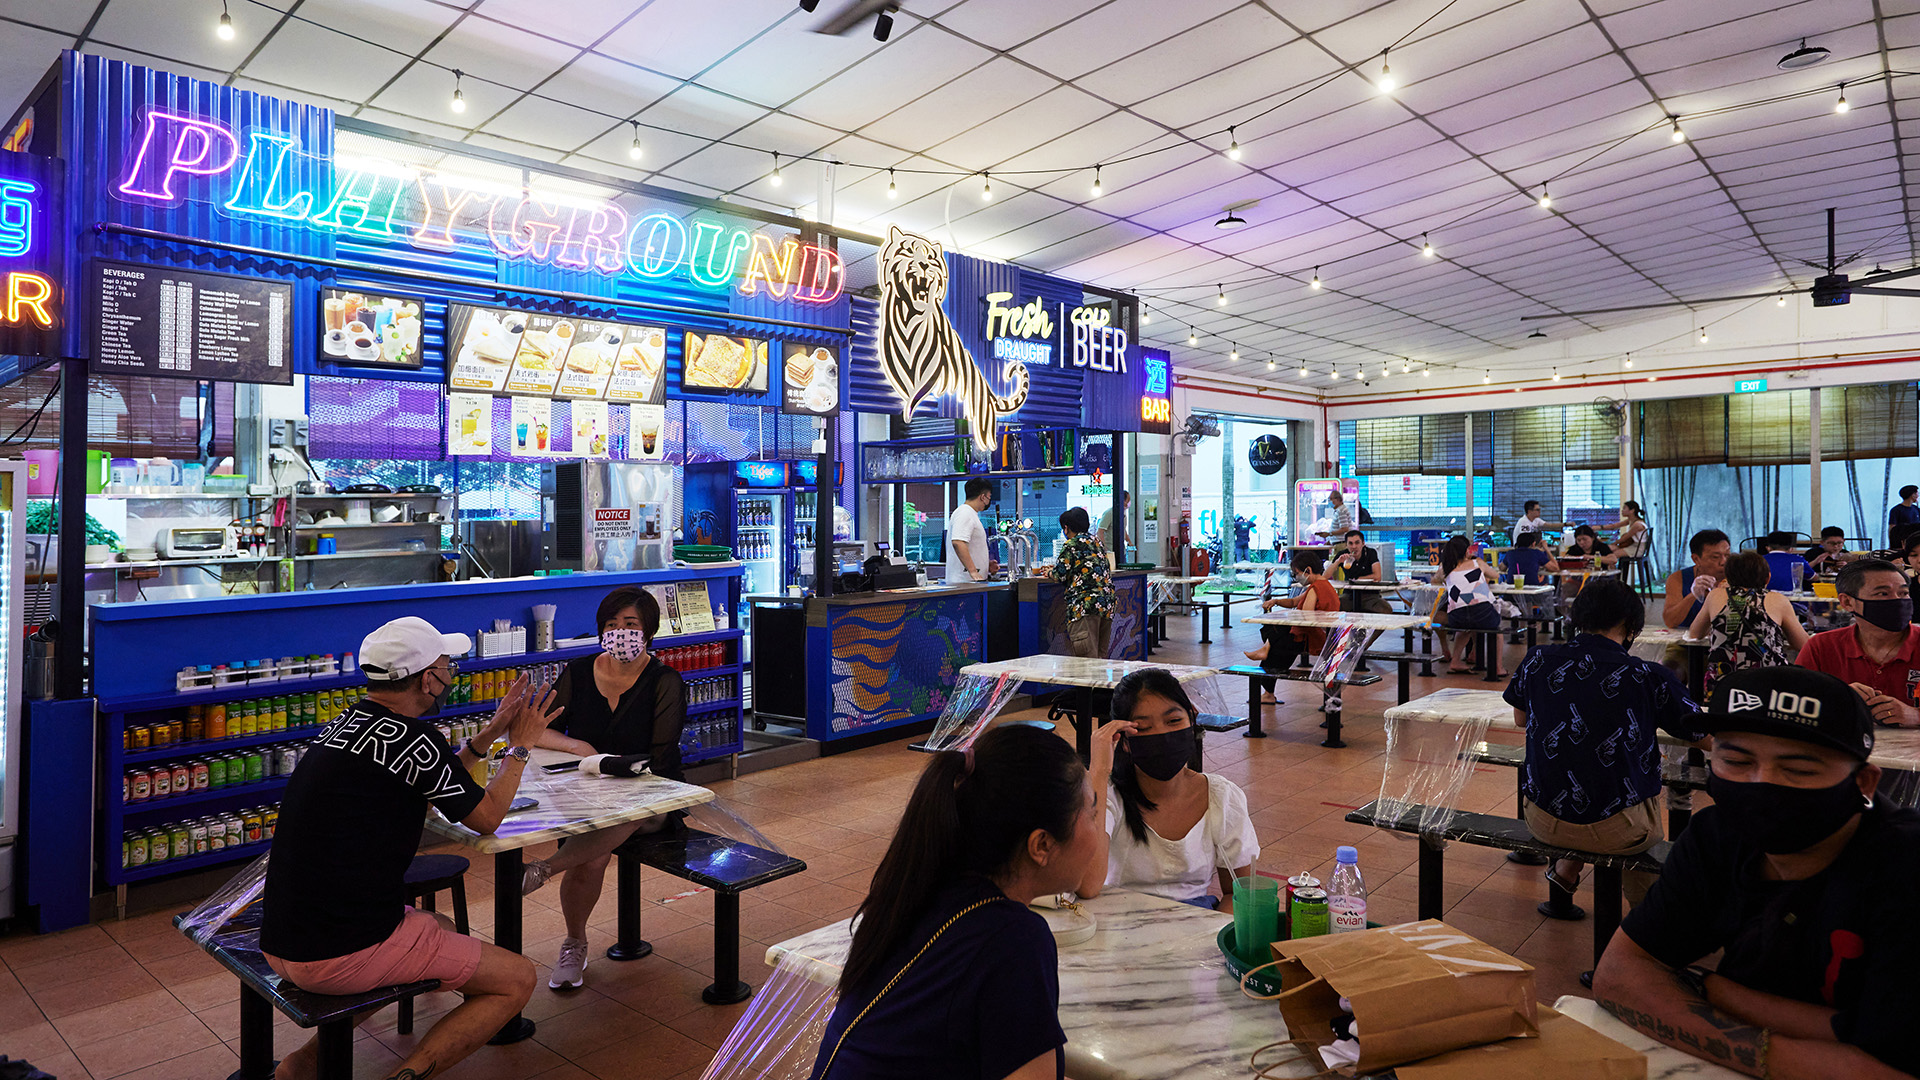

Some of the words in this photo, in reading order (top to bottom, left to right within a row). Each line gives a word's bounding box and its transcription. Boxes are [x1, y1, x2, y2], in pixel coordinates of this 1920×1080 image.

[118, 111, 847, 303] PLAYGROUND
[103, 268, 145, 280] BEVERAGES
[986, 291, 1053, 341] Fresh
[1071, 306, 1110, 328] COLD
[995, 337, 1052, 365] DRAUGHT
[1073, 322, 1128, 374] BEER
[1145, 356, 1168, 395] 酒
[1741, 381, 1760, 391] EXIT
[1141, 396, 1171, 423] BAR
[749, 464, 775, 480] Tiger
[597, 510, 628, 519] NOTICE
[1198, 510, 1257, 534] flx
[1768, 689, 1821, 719] 100
[1767, 712, 1819, 727] 1920-2020
[313, 708, 466, 800] BERRY
[1337, 916, 1363, 926] evian
